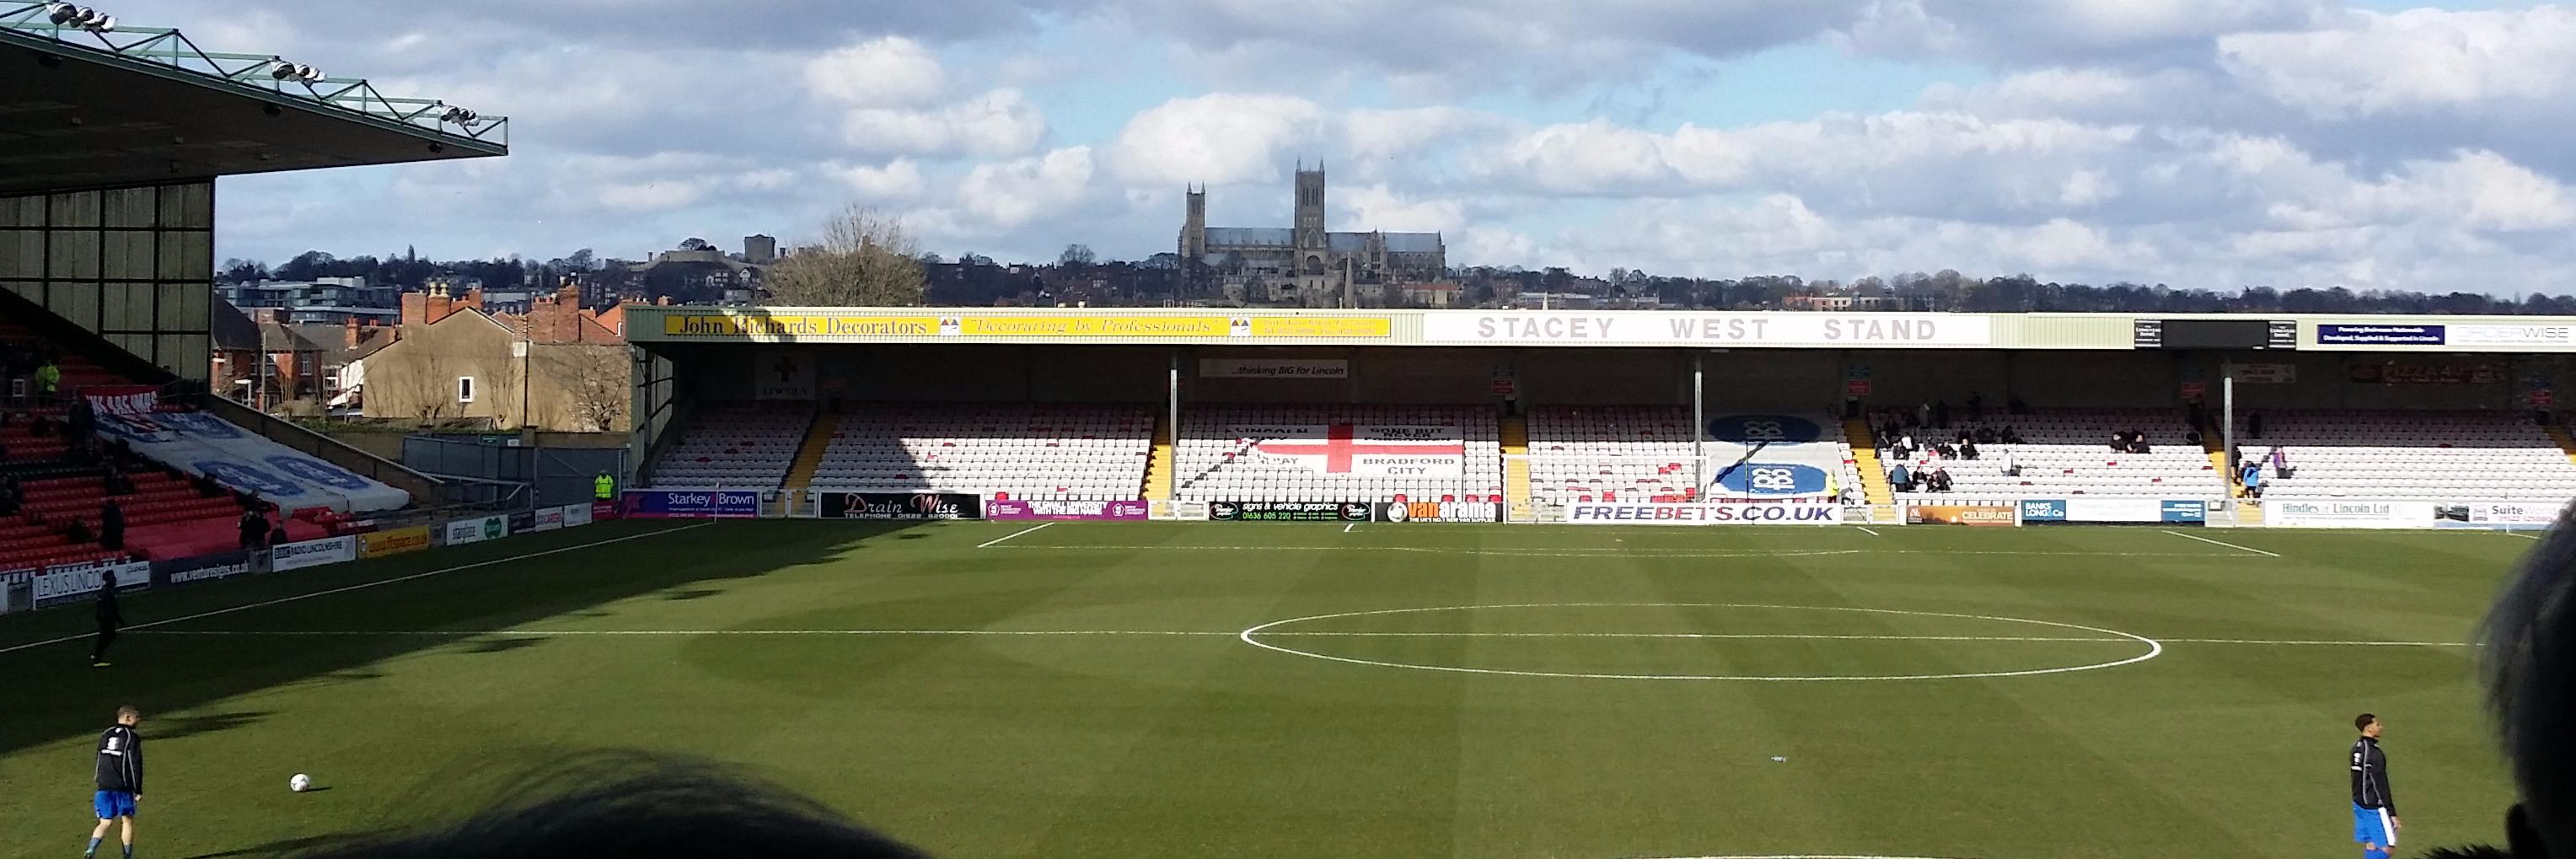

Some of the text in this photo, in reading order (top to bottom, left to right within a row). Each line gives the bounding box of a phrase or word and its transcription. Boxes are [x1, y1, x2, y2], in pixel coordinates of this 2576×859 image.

[679, 317, 927, 334] John Richards Decorators
[1075, 319, 1093, 333] by
[1478, 317, 1935, 340] STACEY WEST STAND
[1296, 366, 1308, 375] for
[1312, 366, 1344, 374] Lincoln
[1387, 466, 1427, 475] CITY
[668, 493, 754, 507] Starkey Brown
[844, 493, 959, 513] Drain Wise
[1242, 502, 1263, 512] signs
[1273, 502, 1301, 511] vehicle
[1303, 503, 1339, 512] graphics
[1408, 502, 1497, 518] vanarama
[1573, 506, 1833, 521] FREEBETS.CO.UK
[2283, 503, 2319, 513] Hindles
[2333, 503, 2369, 513] Lincoln
[2374, 503, 2390, 513] Ltd
[1962, 511, 2013, 520] CELEBRATE
[170, 560, 250, 584] www.venturesigns.co.uk
[38, 569, 104, 597] LEXUS LINCO
